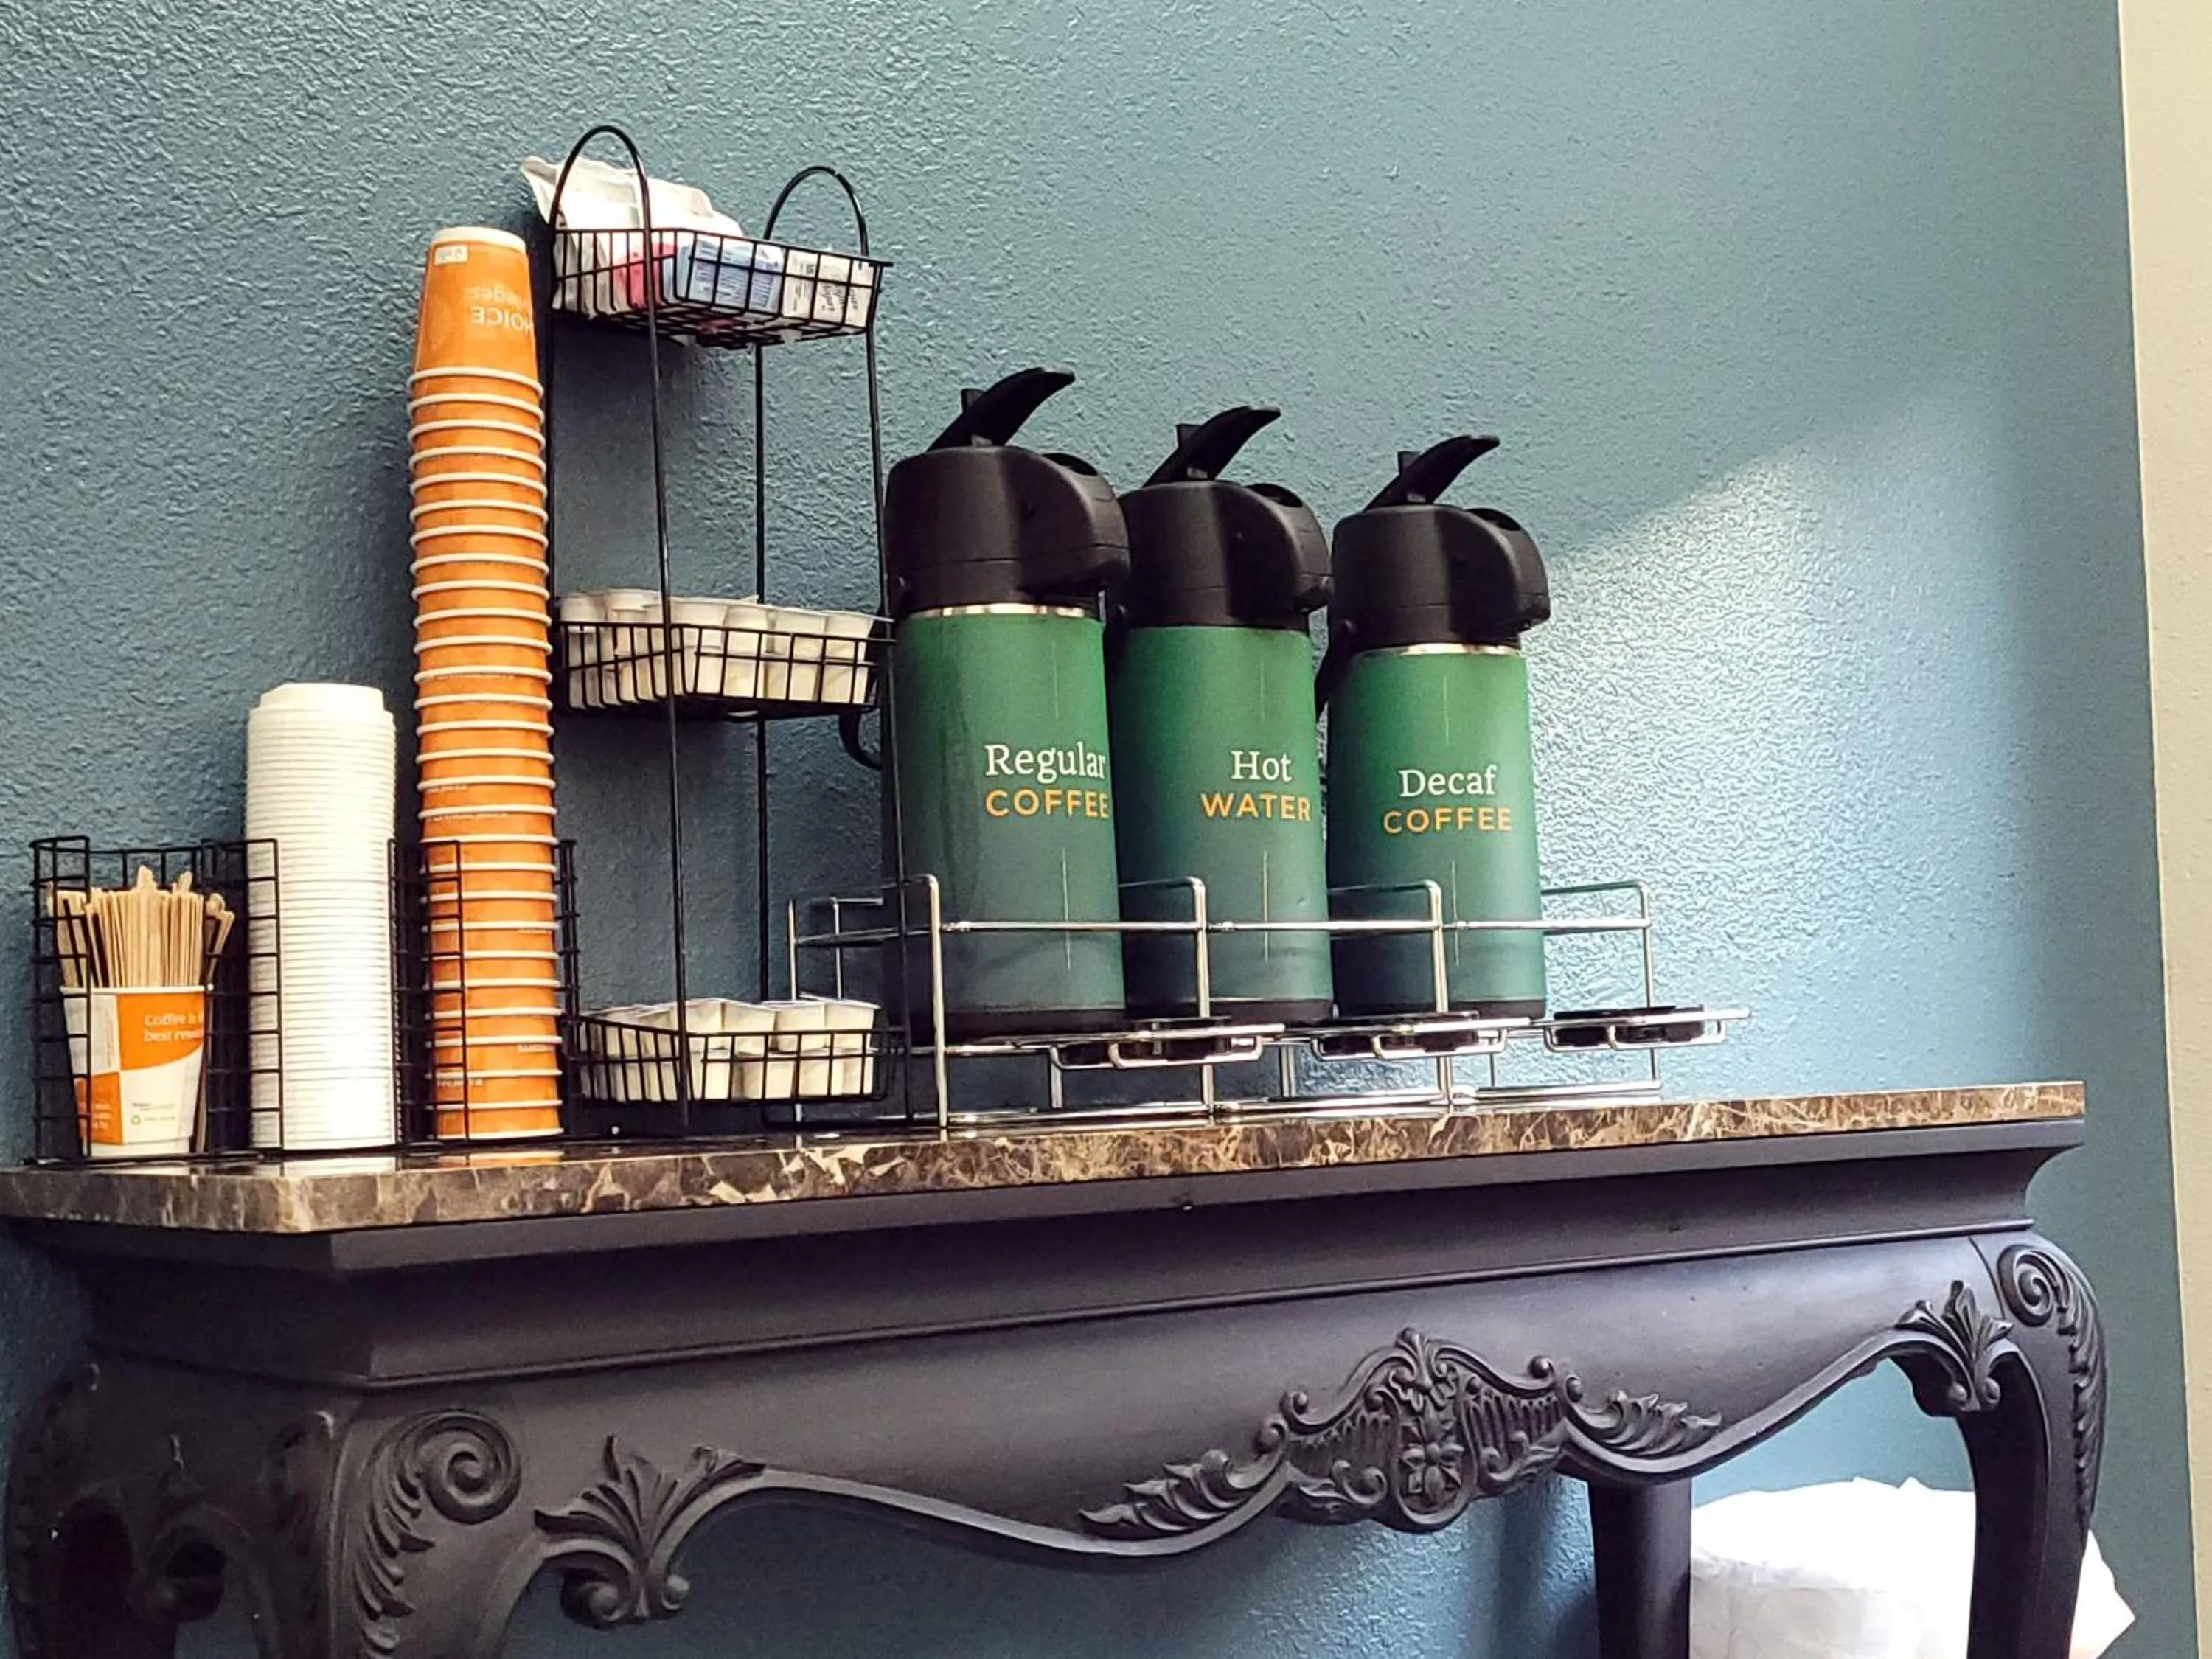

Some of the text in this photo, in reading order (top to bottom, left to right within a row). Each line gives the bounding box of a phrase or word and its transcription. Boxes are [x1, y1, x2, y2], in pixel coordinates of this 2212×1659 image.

[471, 306, 534, 335] HOICE
[984, 741, 1106, 784] Regular
[1231, 750, 1293, 782] Hot
[1399, 765, 1498, 797] Decaf
[986, 789, 1109, 818] COFFEE
[1200, 792, 1311, 821] WATER
[1383, 807, 1513, 834] COFFEE
